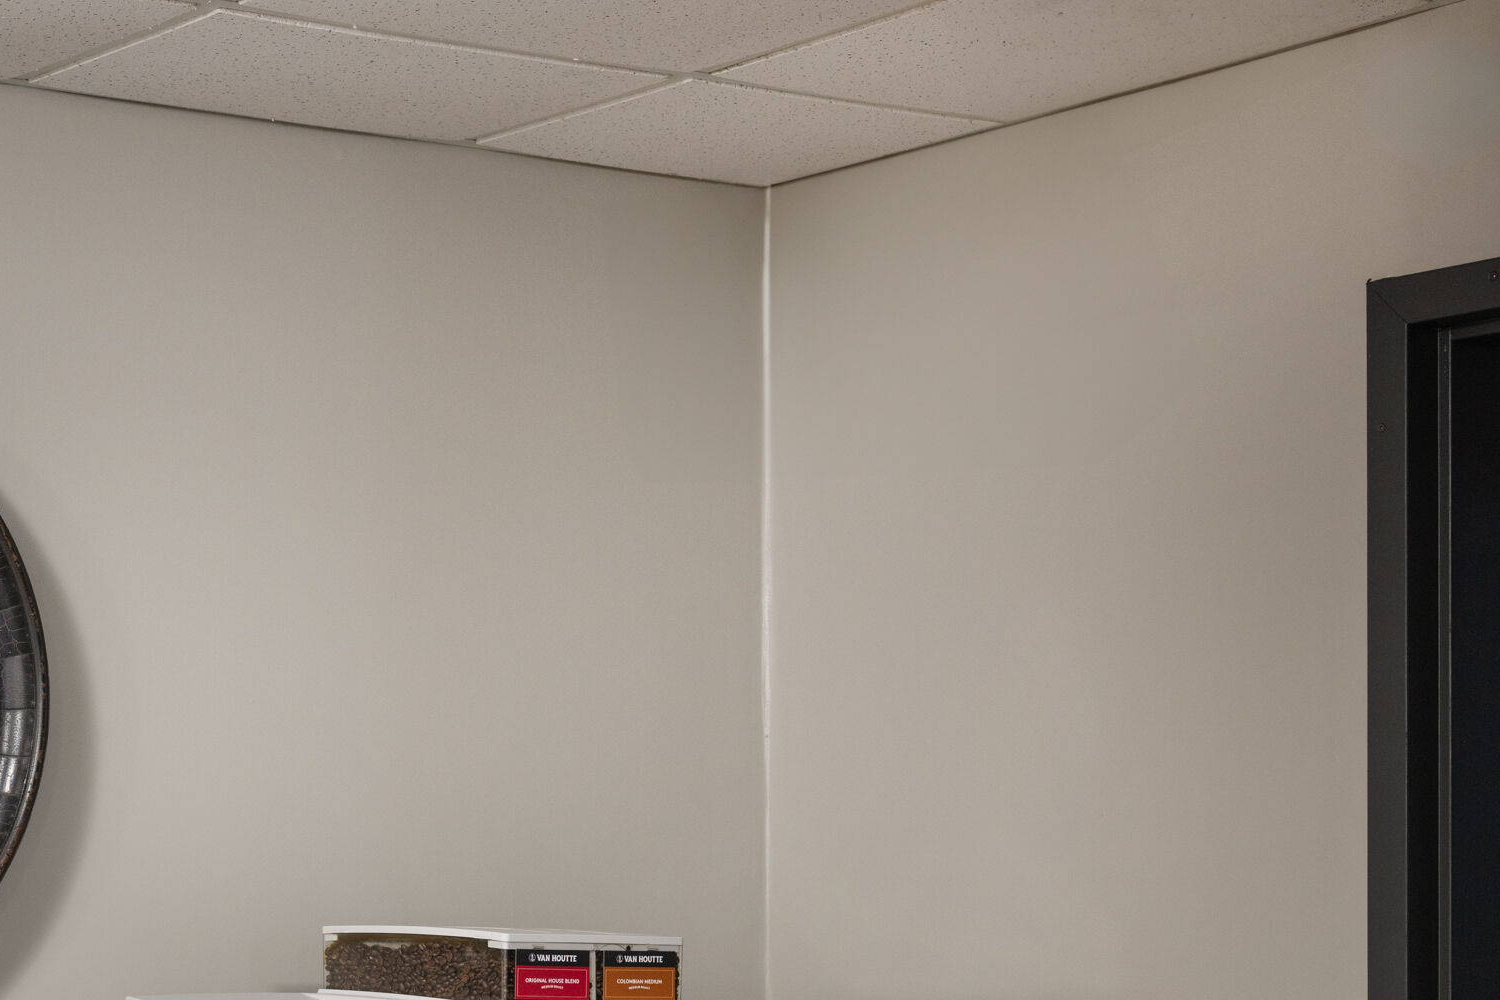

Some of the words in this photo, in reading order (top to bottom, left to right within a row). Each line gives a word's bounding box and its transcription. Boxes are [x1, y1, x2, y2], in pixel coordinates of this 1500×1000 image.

[537, 954, 550, 962] VAN
[551, 954, 577, 962] HOUTTE
[624, 955, 638, 963] VAN
[638, 955, 663, 963] HOUTTE
